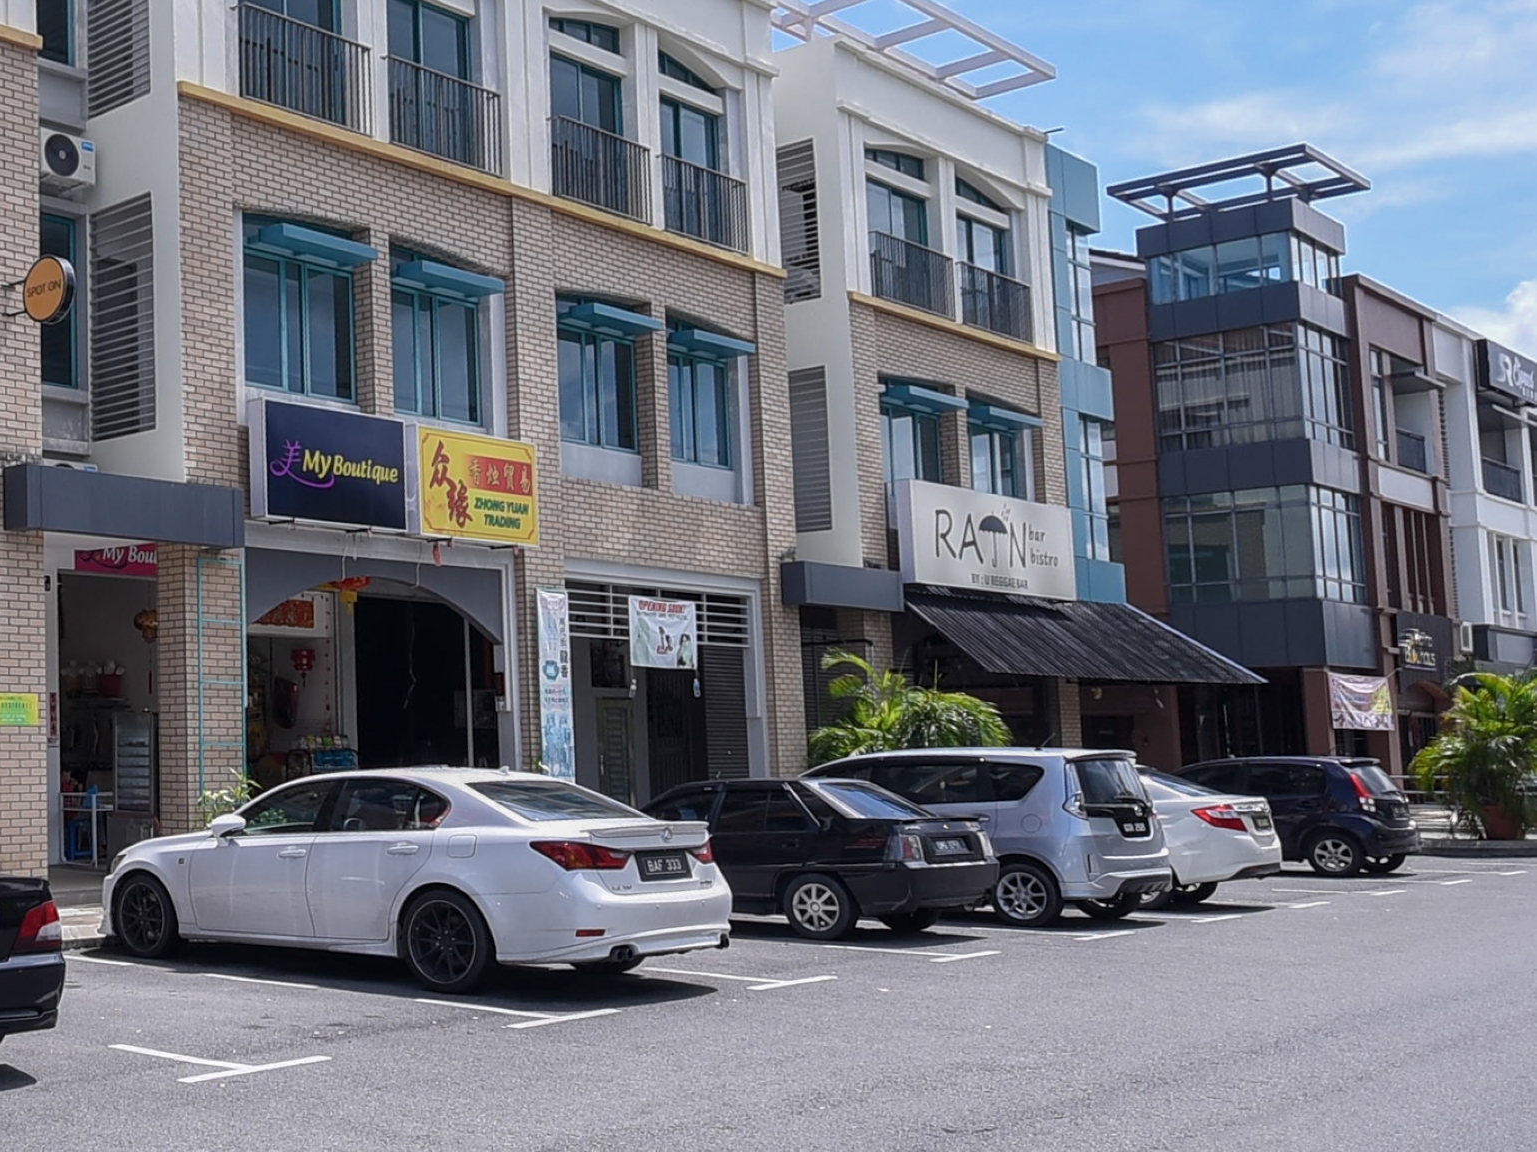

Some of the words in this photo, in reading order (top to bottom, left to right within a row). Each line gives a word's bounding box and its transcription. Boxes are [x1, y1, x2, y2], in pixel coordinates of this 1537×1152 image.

[26, 283, 46, 298] SPOT
[47, 278, 62, 293] ON
[302, 448, 332, 479] My
[332, 454, 399, 485] Boutique
[474, 496, 505, 513] ZHONG
[506, 501, 530, 515] YUAN
[484, 514, 521, 530] TRADING
[1028, 524, 1046, 542] bar
[103, 546, 124, 564] My
[1029, 548, 1059, 567] bistro
